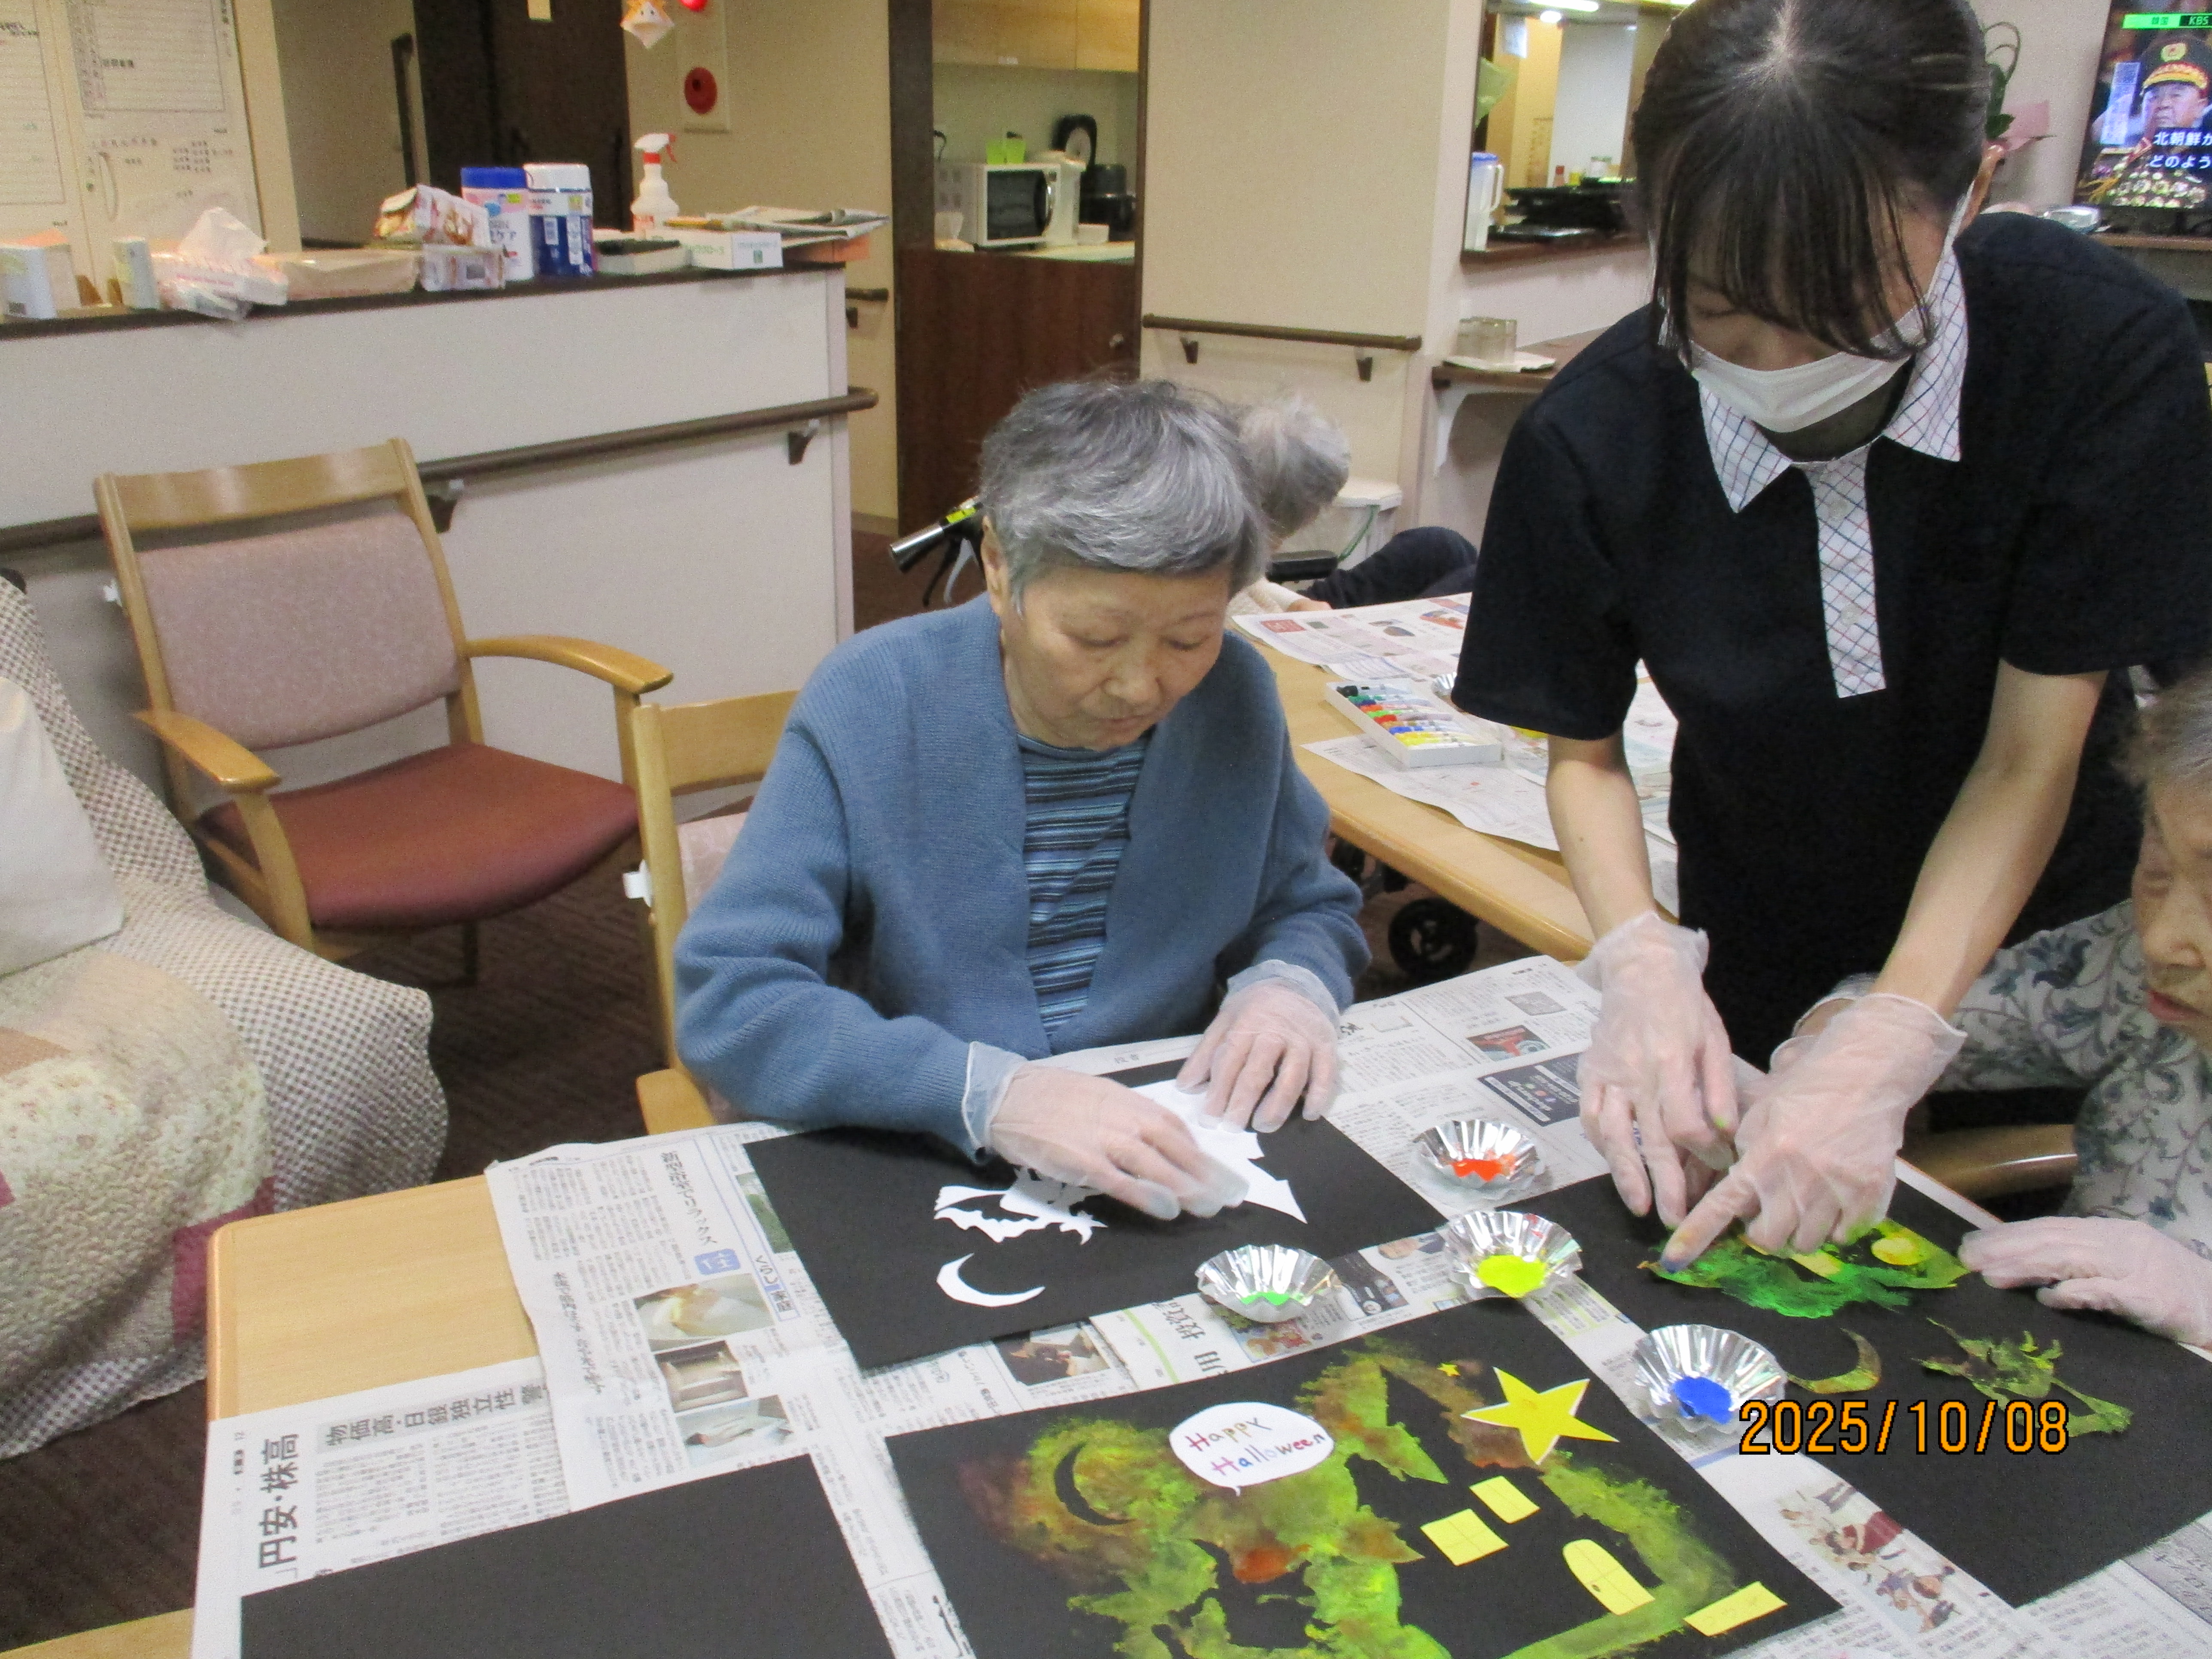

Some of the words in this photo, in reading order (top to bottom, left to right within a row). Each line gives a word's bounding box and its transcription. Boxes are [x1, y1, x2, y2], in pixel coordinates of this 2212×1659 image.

[2188, 15, 2209, 25] KBS
[2149, 155, 2212, 169] どのよう
[1194, 1351, 1228, 1374] 用
[1210, 1433, 1326, 1476] Halloween
